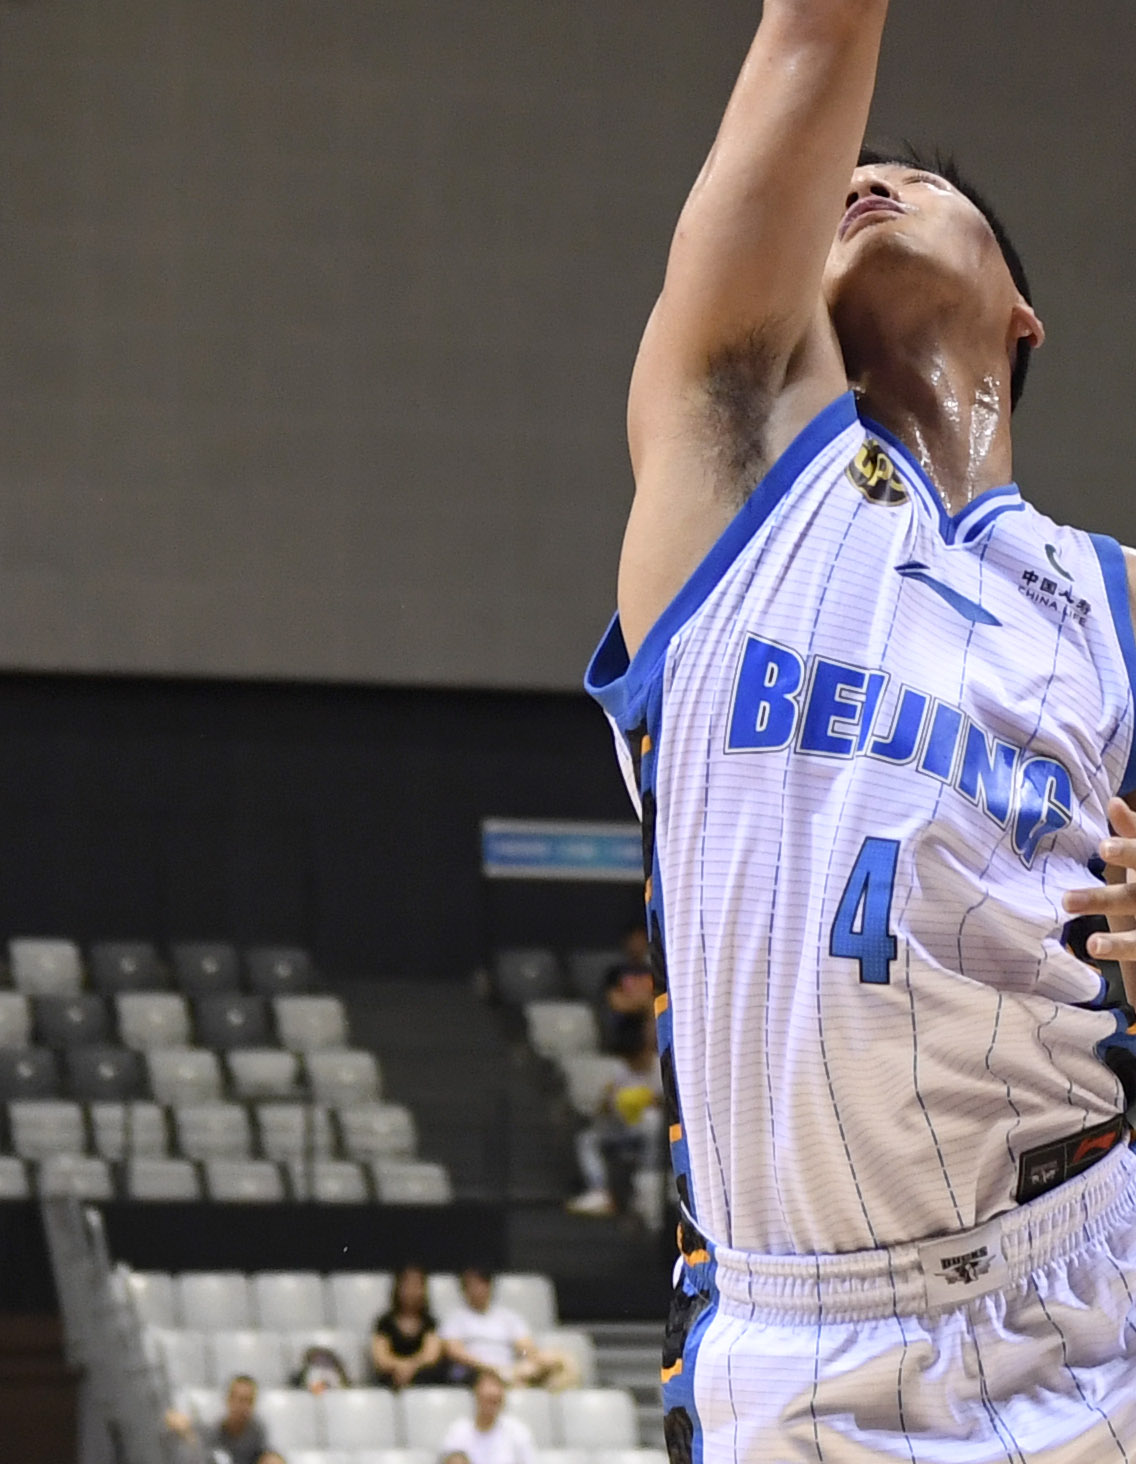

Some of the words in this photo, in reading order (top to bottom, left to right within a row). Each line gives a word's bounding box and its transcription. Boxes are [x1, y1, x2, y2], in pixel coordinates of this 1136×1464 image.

[1018, 585, 1058, 611] CHINA
[723, 631, 1073, 870] BEIJING
[828, 836, 901, 985] 4
